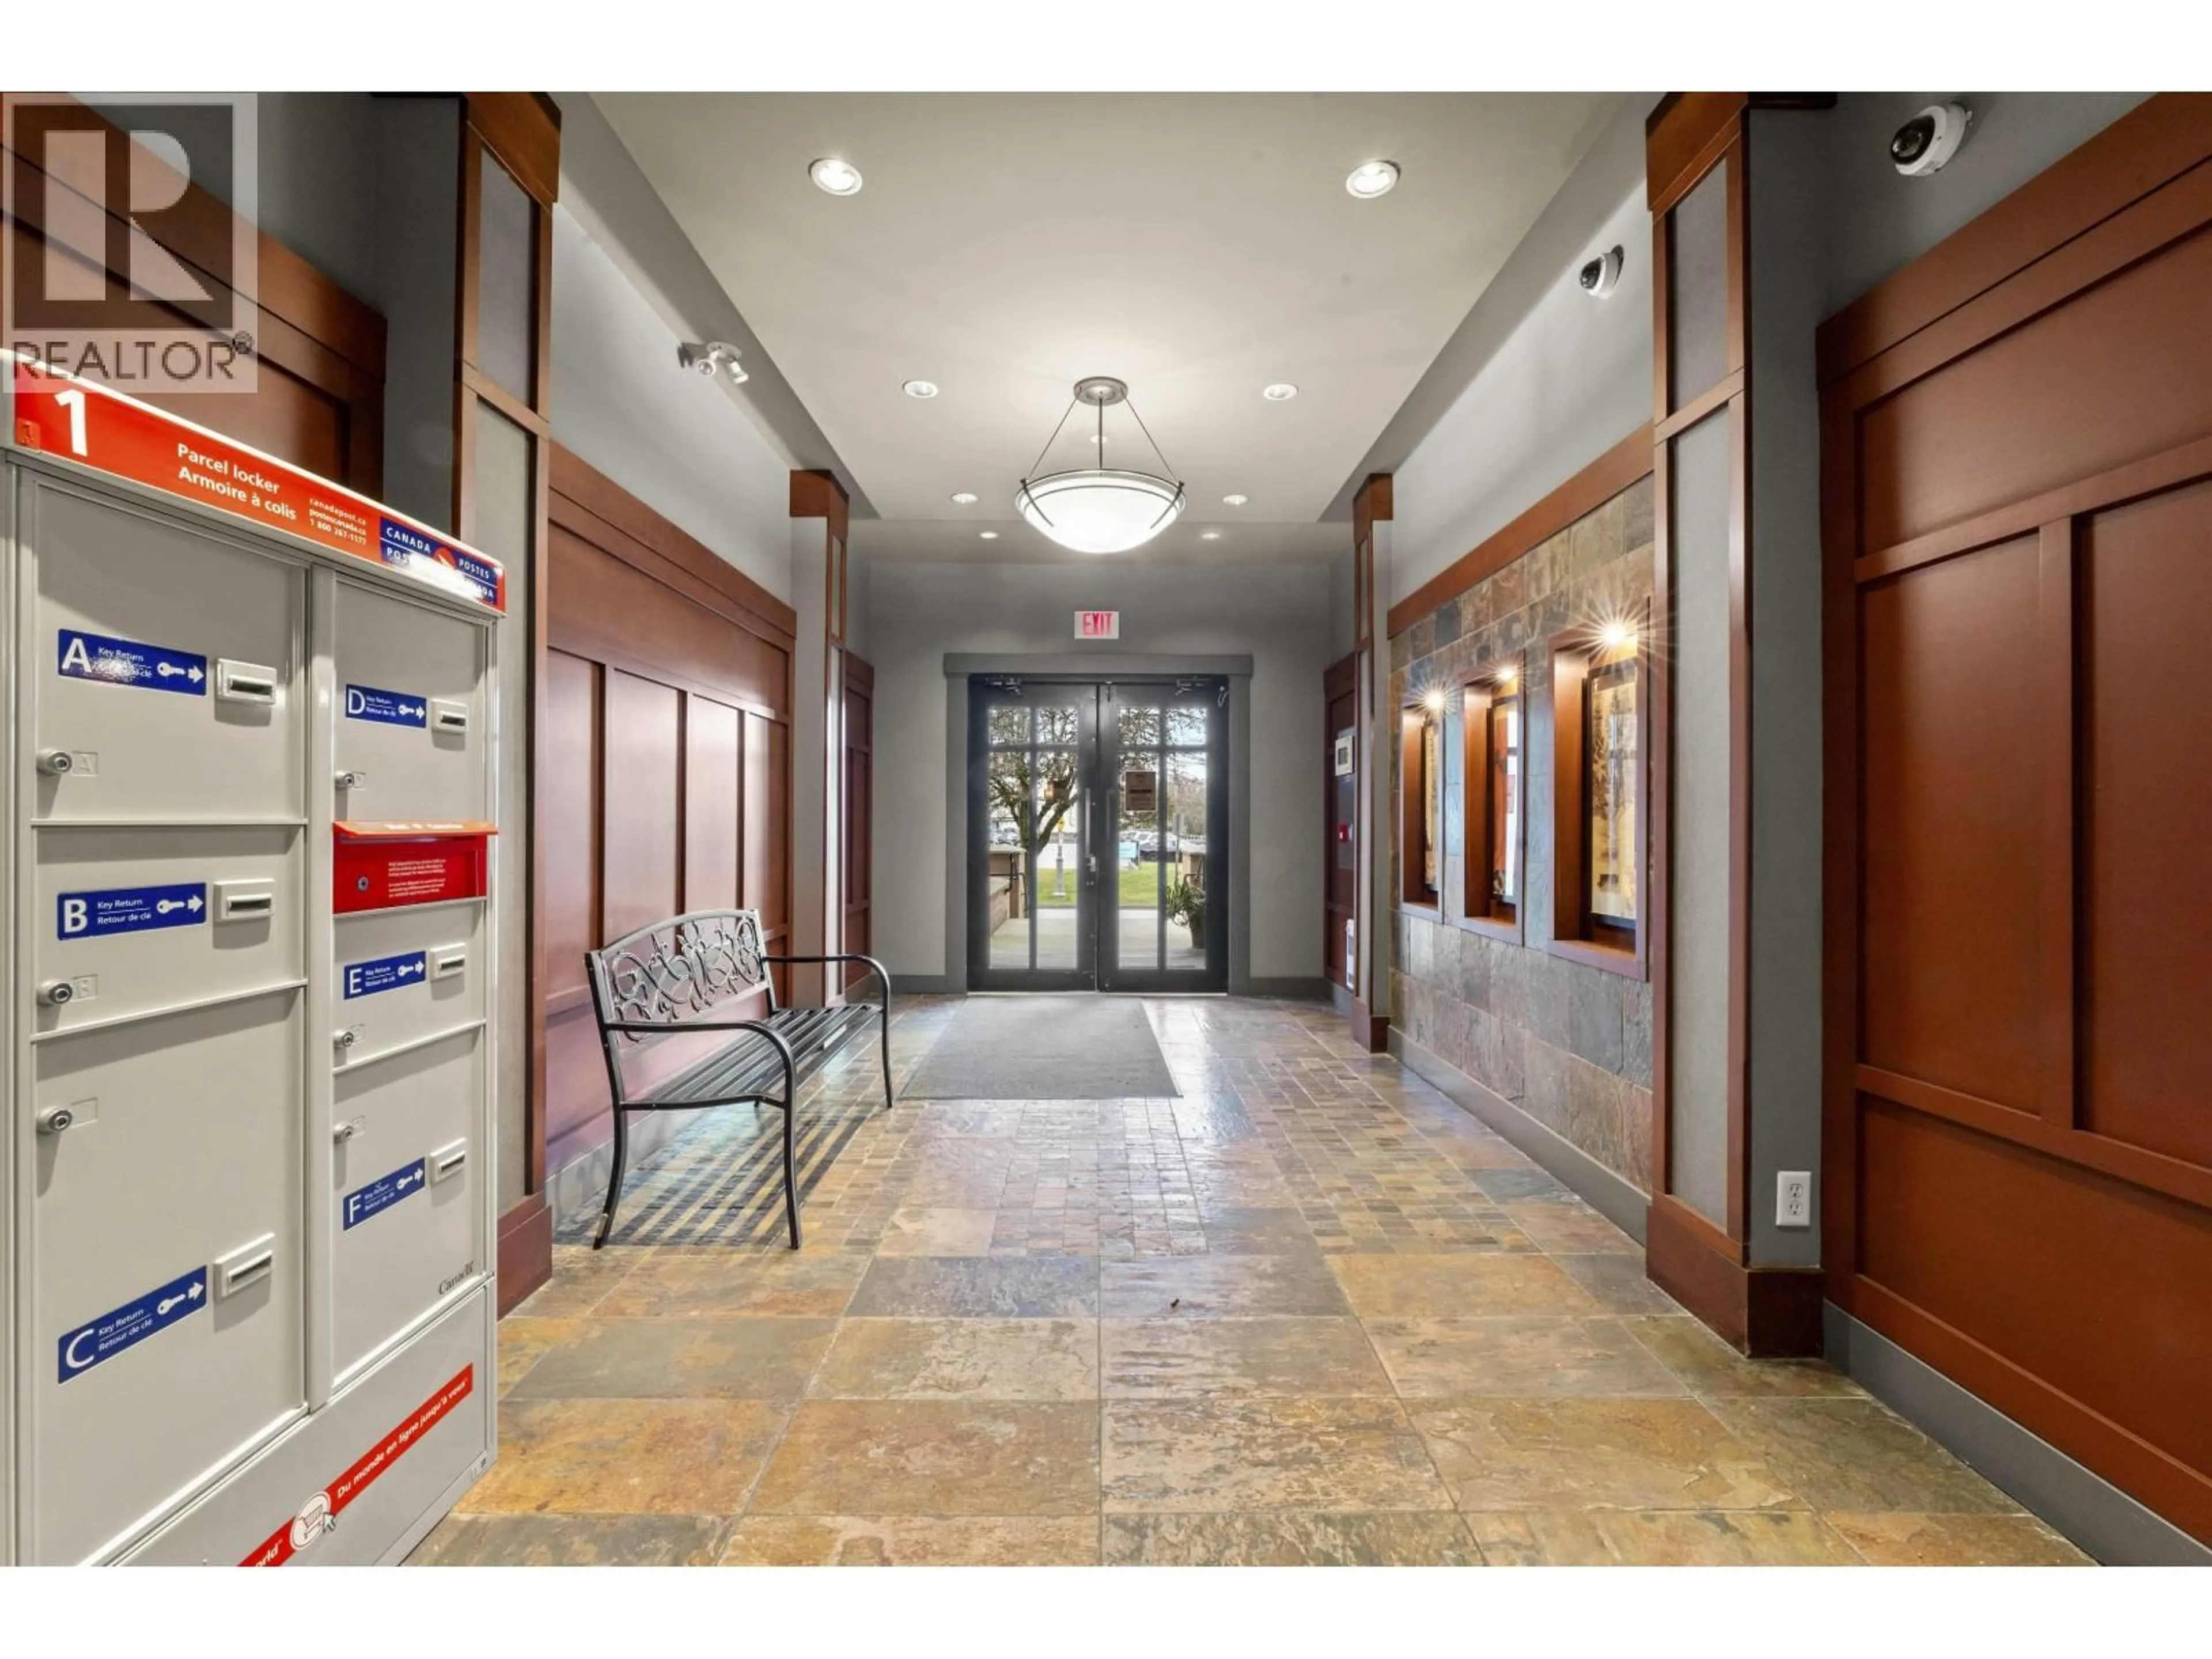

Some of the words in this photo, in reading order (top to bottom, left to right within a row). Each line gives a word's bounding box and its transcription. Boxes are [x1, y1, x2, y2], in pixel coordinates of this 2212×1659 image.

[54, 389, 88, 457] 1
[177, 443, 229, 475] Parcel
[233, 464, 280, 494] locker
[178, 466, 247, 502] Armoire
[251, 492, 261, 507] à
[264, 501, 297, 520] colis
[387, 527, 431, 554] CANADA
[387, 547, 410, 563] POS
[459, 557, 490, 579] POSTES
[1083, 612, 1112, 635] EXIT
[61, 638, 92, 673] A
[348, 688, 366, 715] D
[64, 899, 88, 934] B
[97, 901, 113, 910] Key
[115, 899, 144, 908] Return
[97, 916, 126, 925] Retour
[128, 913, 139, 922] de
[349, 968, 362, 995] E
[349, 1194, 362, 1224] F
[99, 1324, 115, 1336] Key
[116, 1309, 144, 1328] Return
[66, 1328, 94, 1369] C
[99, 1332, 127, 1351] Retour
[336, 1481, 352, 1499] Du
[353, 1451, 385, 1485] monde
[387, 1441, 398, 1456] en
[398, 1422, 419, 1444] ligne
[448, 1380, 465, 1399] vous
